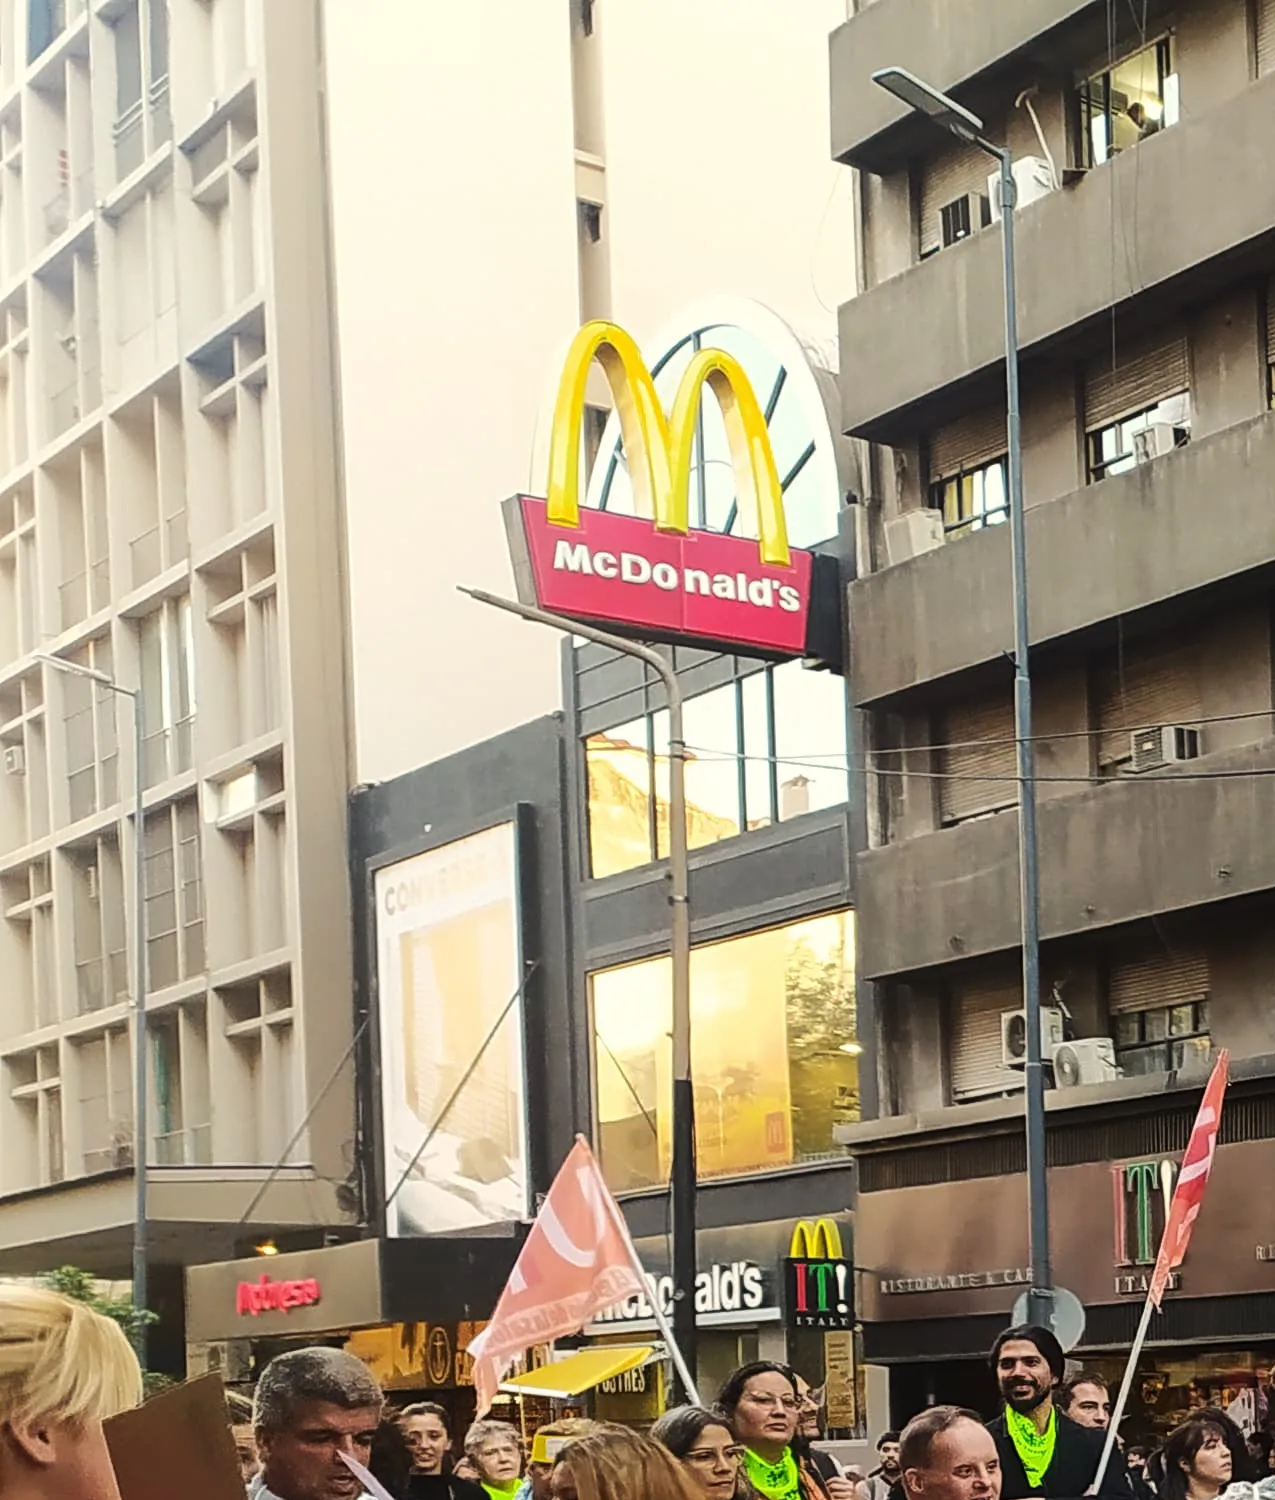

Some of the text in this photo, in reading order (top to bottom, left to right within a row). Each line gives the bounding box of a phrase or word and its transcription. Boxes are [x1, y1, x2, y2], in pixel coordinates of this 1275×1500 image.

[553, 540, 801, 612] McDonald's
[792, 1263, 849, 1314] IT!
[1115, 1271, 1181, 1293] ITAY
[796, 1316, 849, 1327] ITALY
